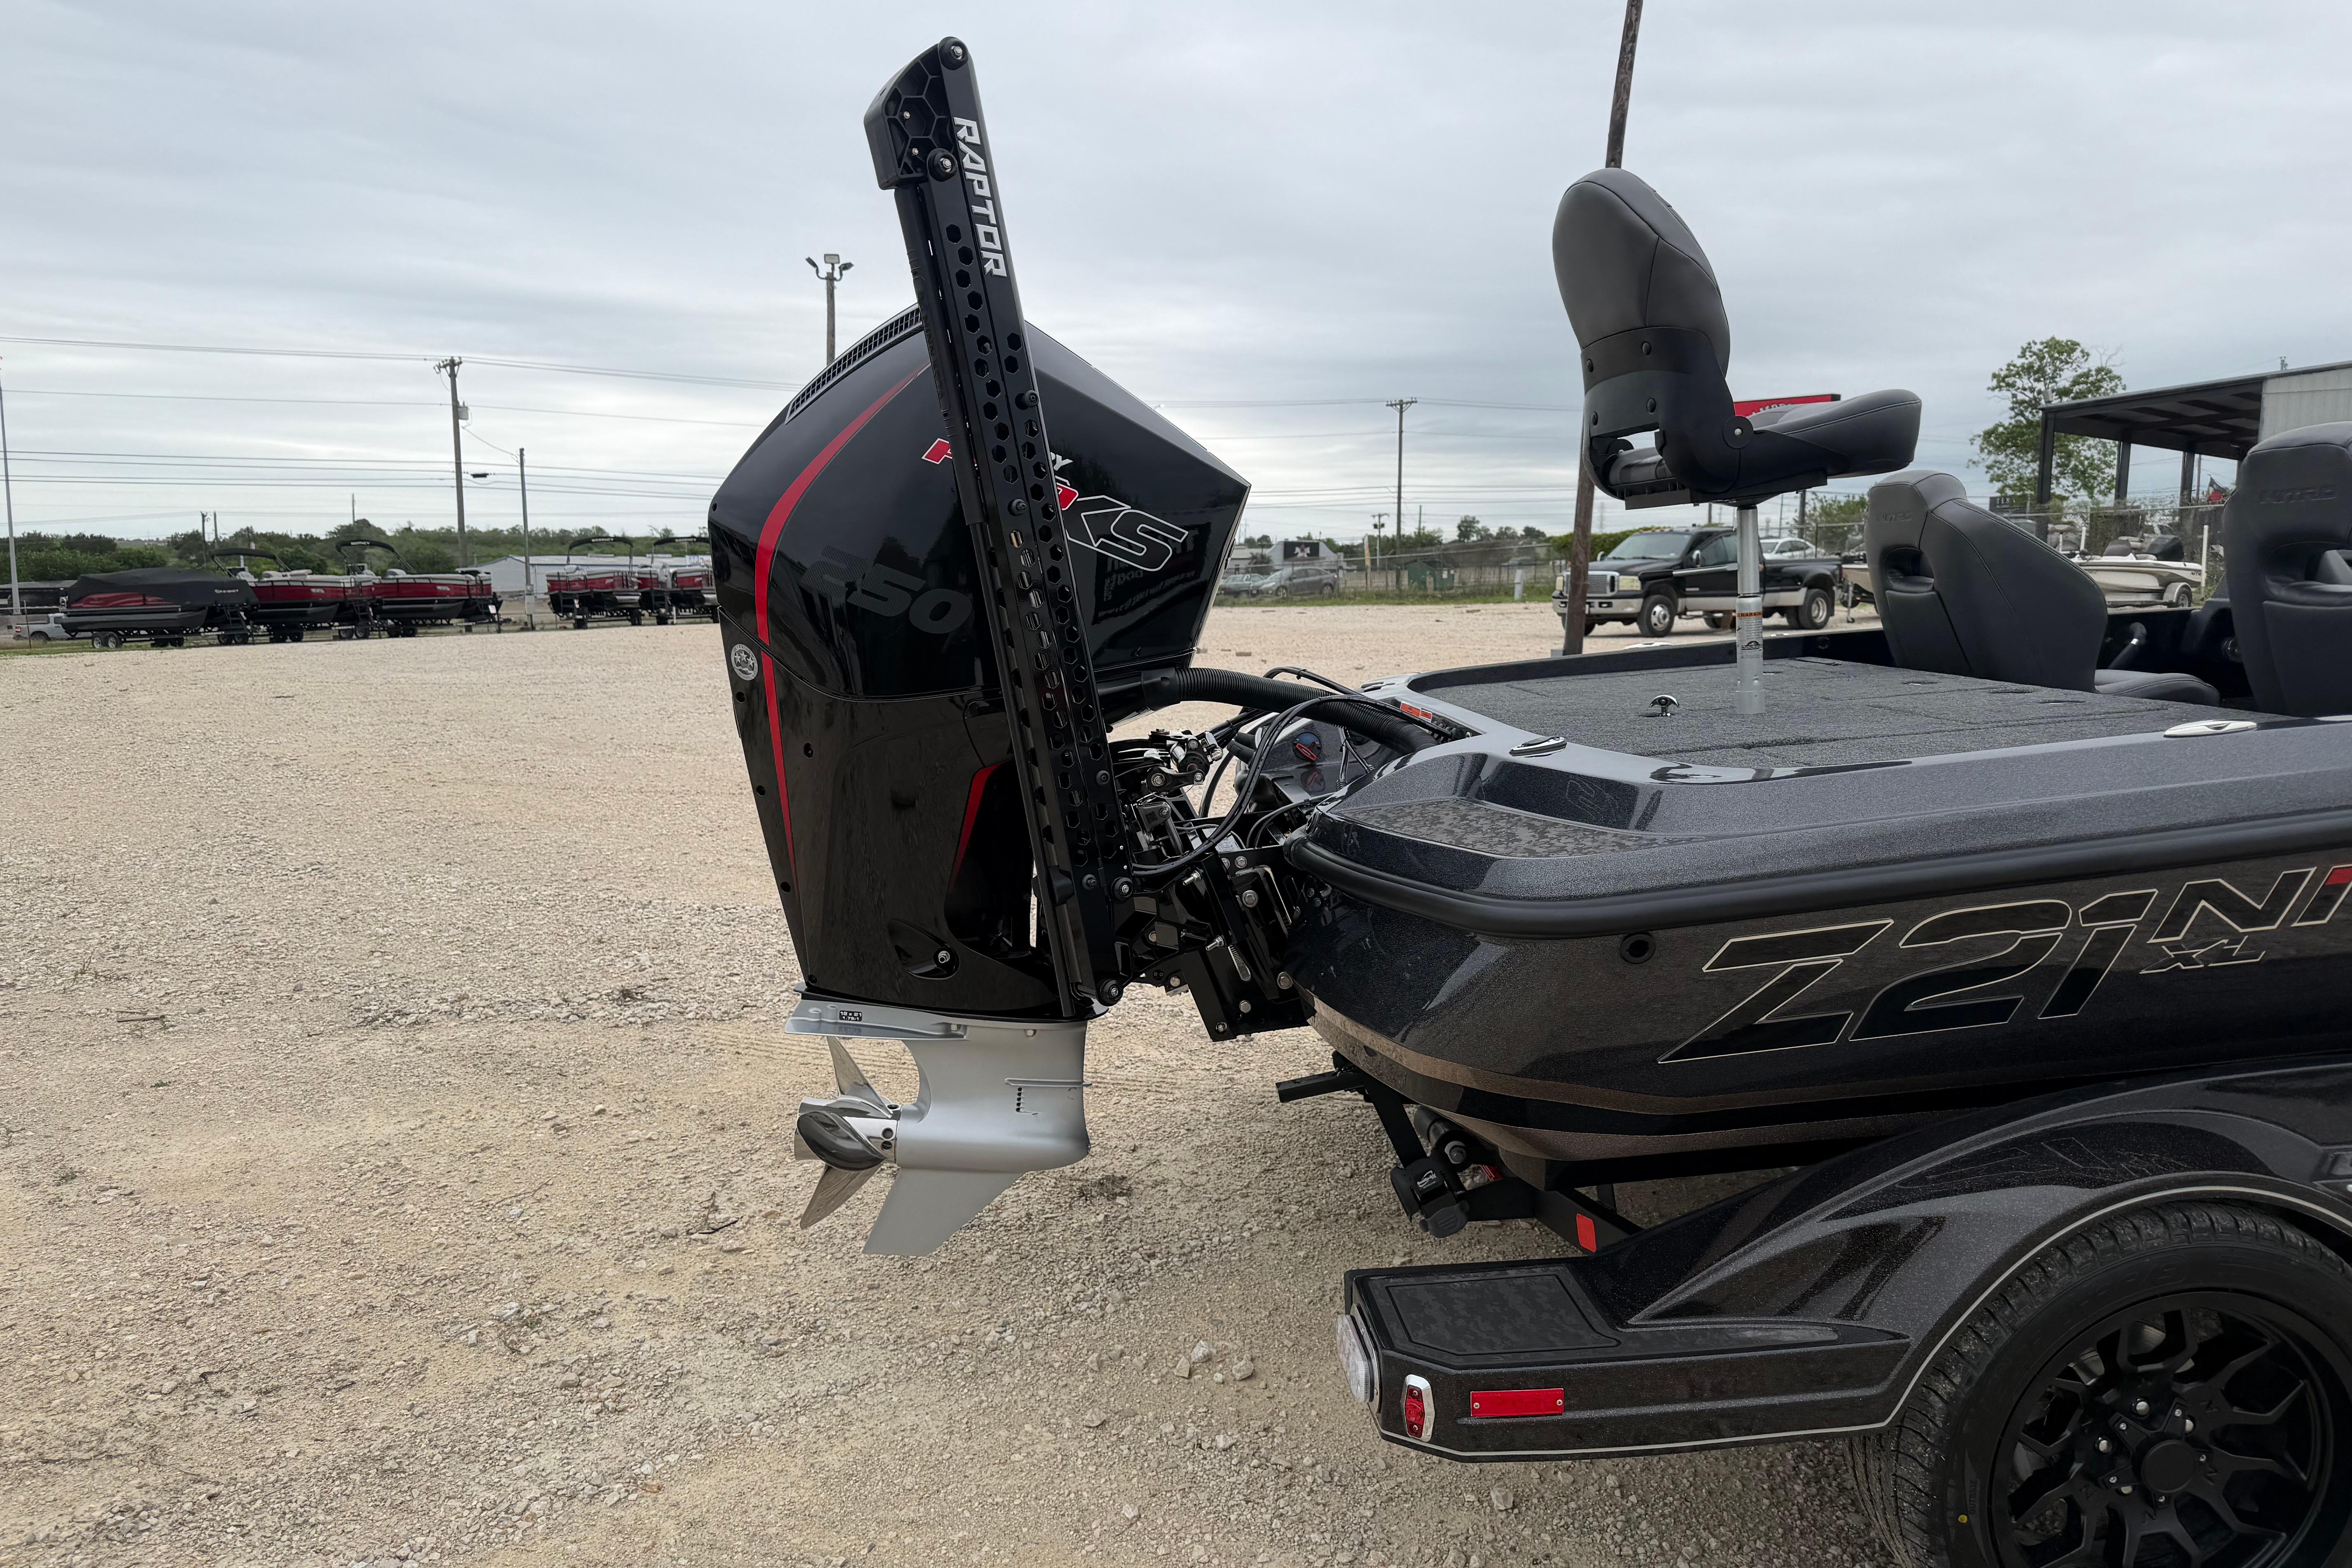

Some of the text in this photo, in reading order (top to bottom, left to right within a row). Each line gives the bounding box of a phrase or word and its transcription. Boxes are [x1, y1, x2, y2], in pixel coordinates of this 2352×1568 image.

[953, 117, 1007, 277] RAPTOR
[1657, 889, 2159, 1063] Z21
[2140, 935, 2266, 974] XL
